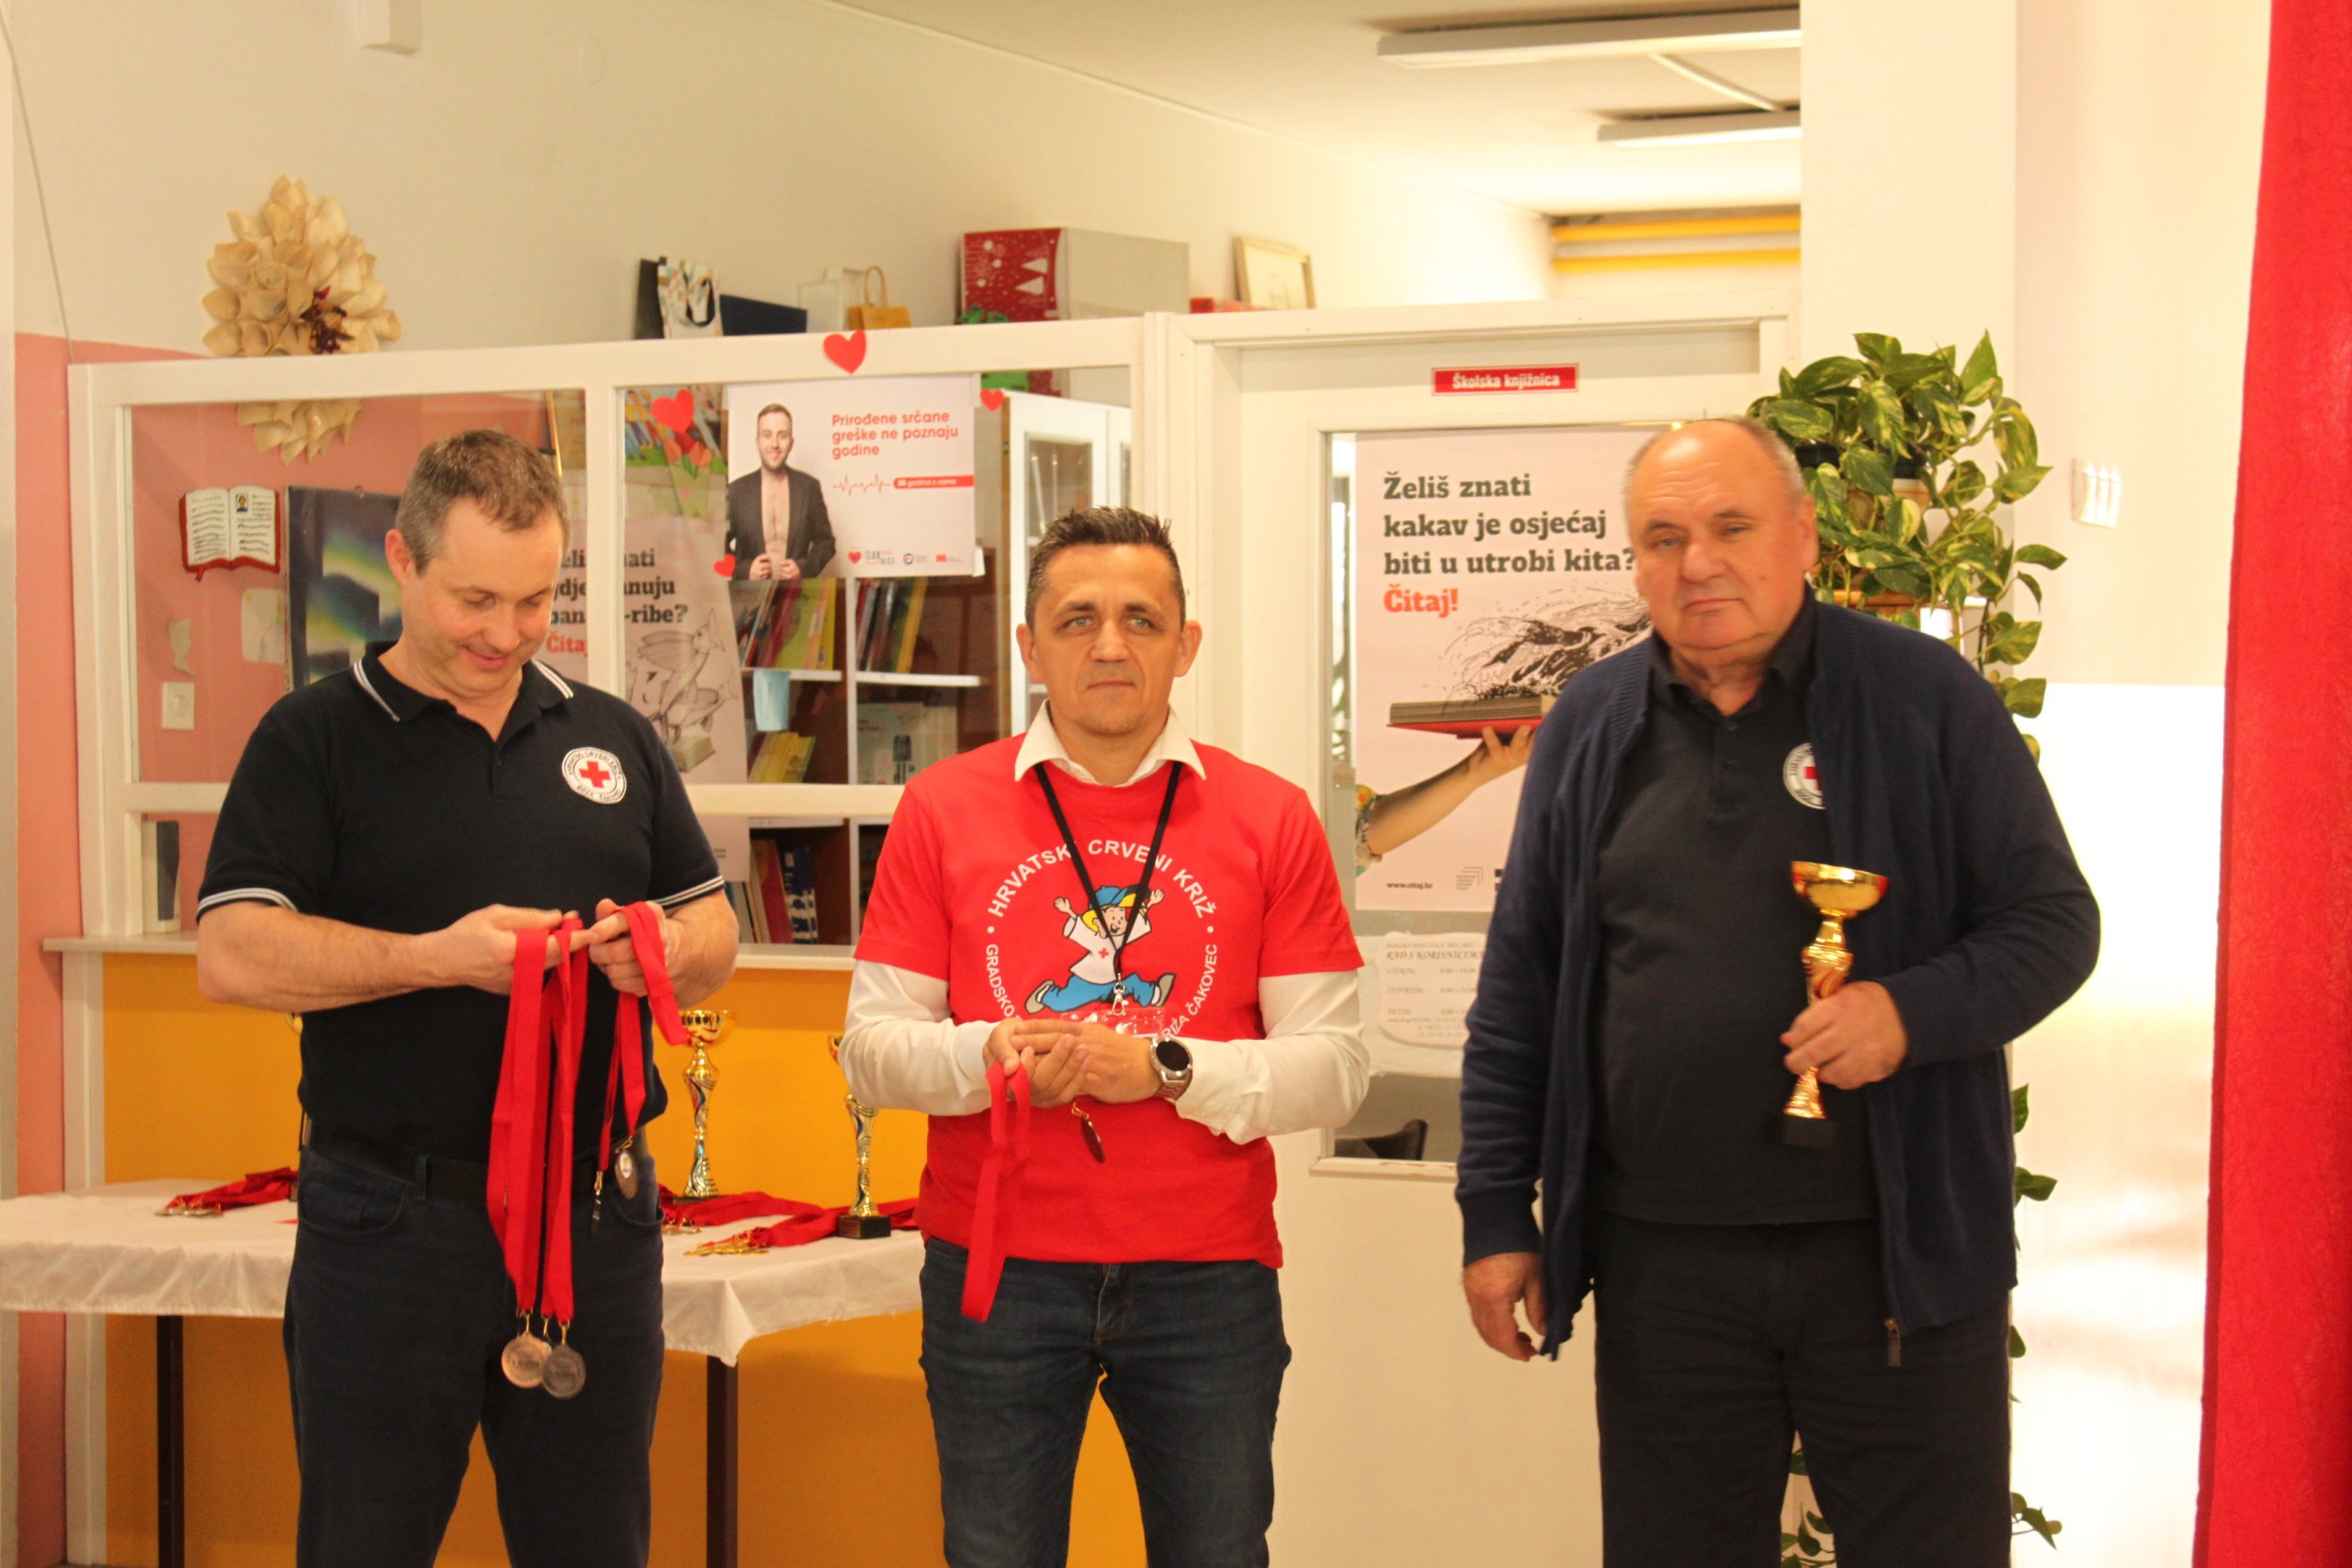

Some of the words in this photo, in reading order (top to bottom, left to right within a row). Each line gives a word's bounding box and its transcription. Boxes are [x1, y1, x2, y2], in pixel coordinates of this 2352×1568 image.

[1453, 372, 1501, 389] Školska
[1504, 372, 1560, 390] knjižnica
[832, 412, 897, 426] Prirođene
[902, 410, 950, 423] srčane
[832, 428, 876, 445] greške
[881, 429, 899, 440] ne
[903, 426, 958, 441] poznaju
[832, 445, 879, 460] godine
[1384, 471, 1450, 500] Želiš
[1459, 473, 1532, 498] znati
[1384, 513, 1468, 537] kakav
[1474, 513, 1500, 542] je
[1510, 510, 1607, 540] osjećaj
[1384, 552, 1431, 574] biti
[1441, 557, 1458, 574] u
[1467, 549, 1555, 573] utrobi
[1564, 547, 1635, 571] kita?
[1384, 583, 1458, 618] Čitaj!
[988, 841, 1076, 918] HRVATSK
[1173, 869, 1216, 919] KRIŽ
[986, 944, 1015, 1017] GRADSKO
[1161, 1015, 1190, 1037] RIŽA
[1187, 944, 1217, 1015] ČAKOVEC
